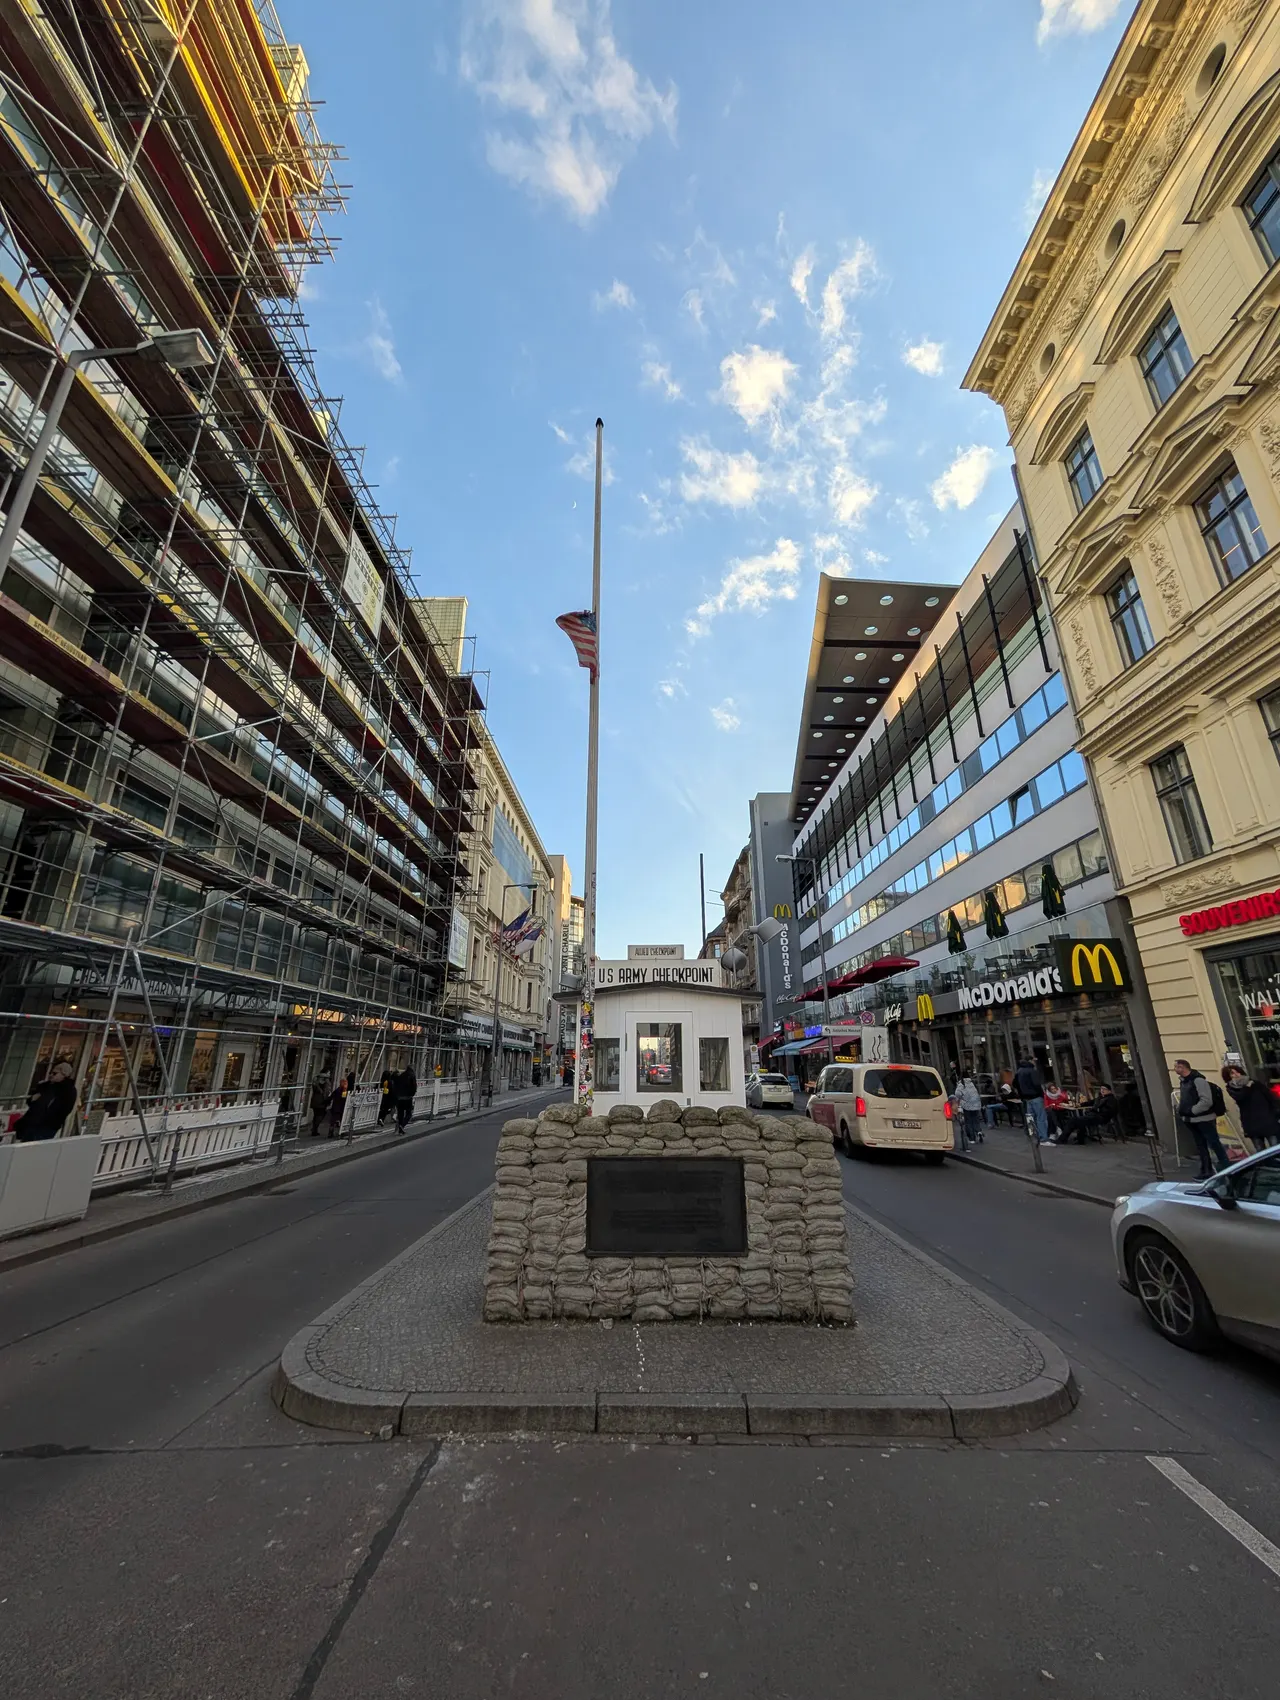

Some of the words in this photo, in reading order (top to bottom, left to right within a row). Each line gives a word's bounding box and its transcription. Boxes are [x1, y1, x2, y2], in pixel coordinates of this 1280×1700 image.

[635, 948, 648, 956] ALLIED
[650, 947, 677, 956] CHECKPOINT
[619, 968, 648, 983] ARMY
[652, 967, 714, 983] CHECKPOINT
[958, 966, 1063, 1010] McDonald's
